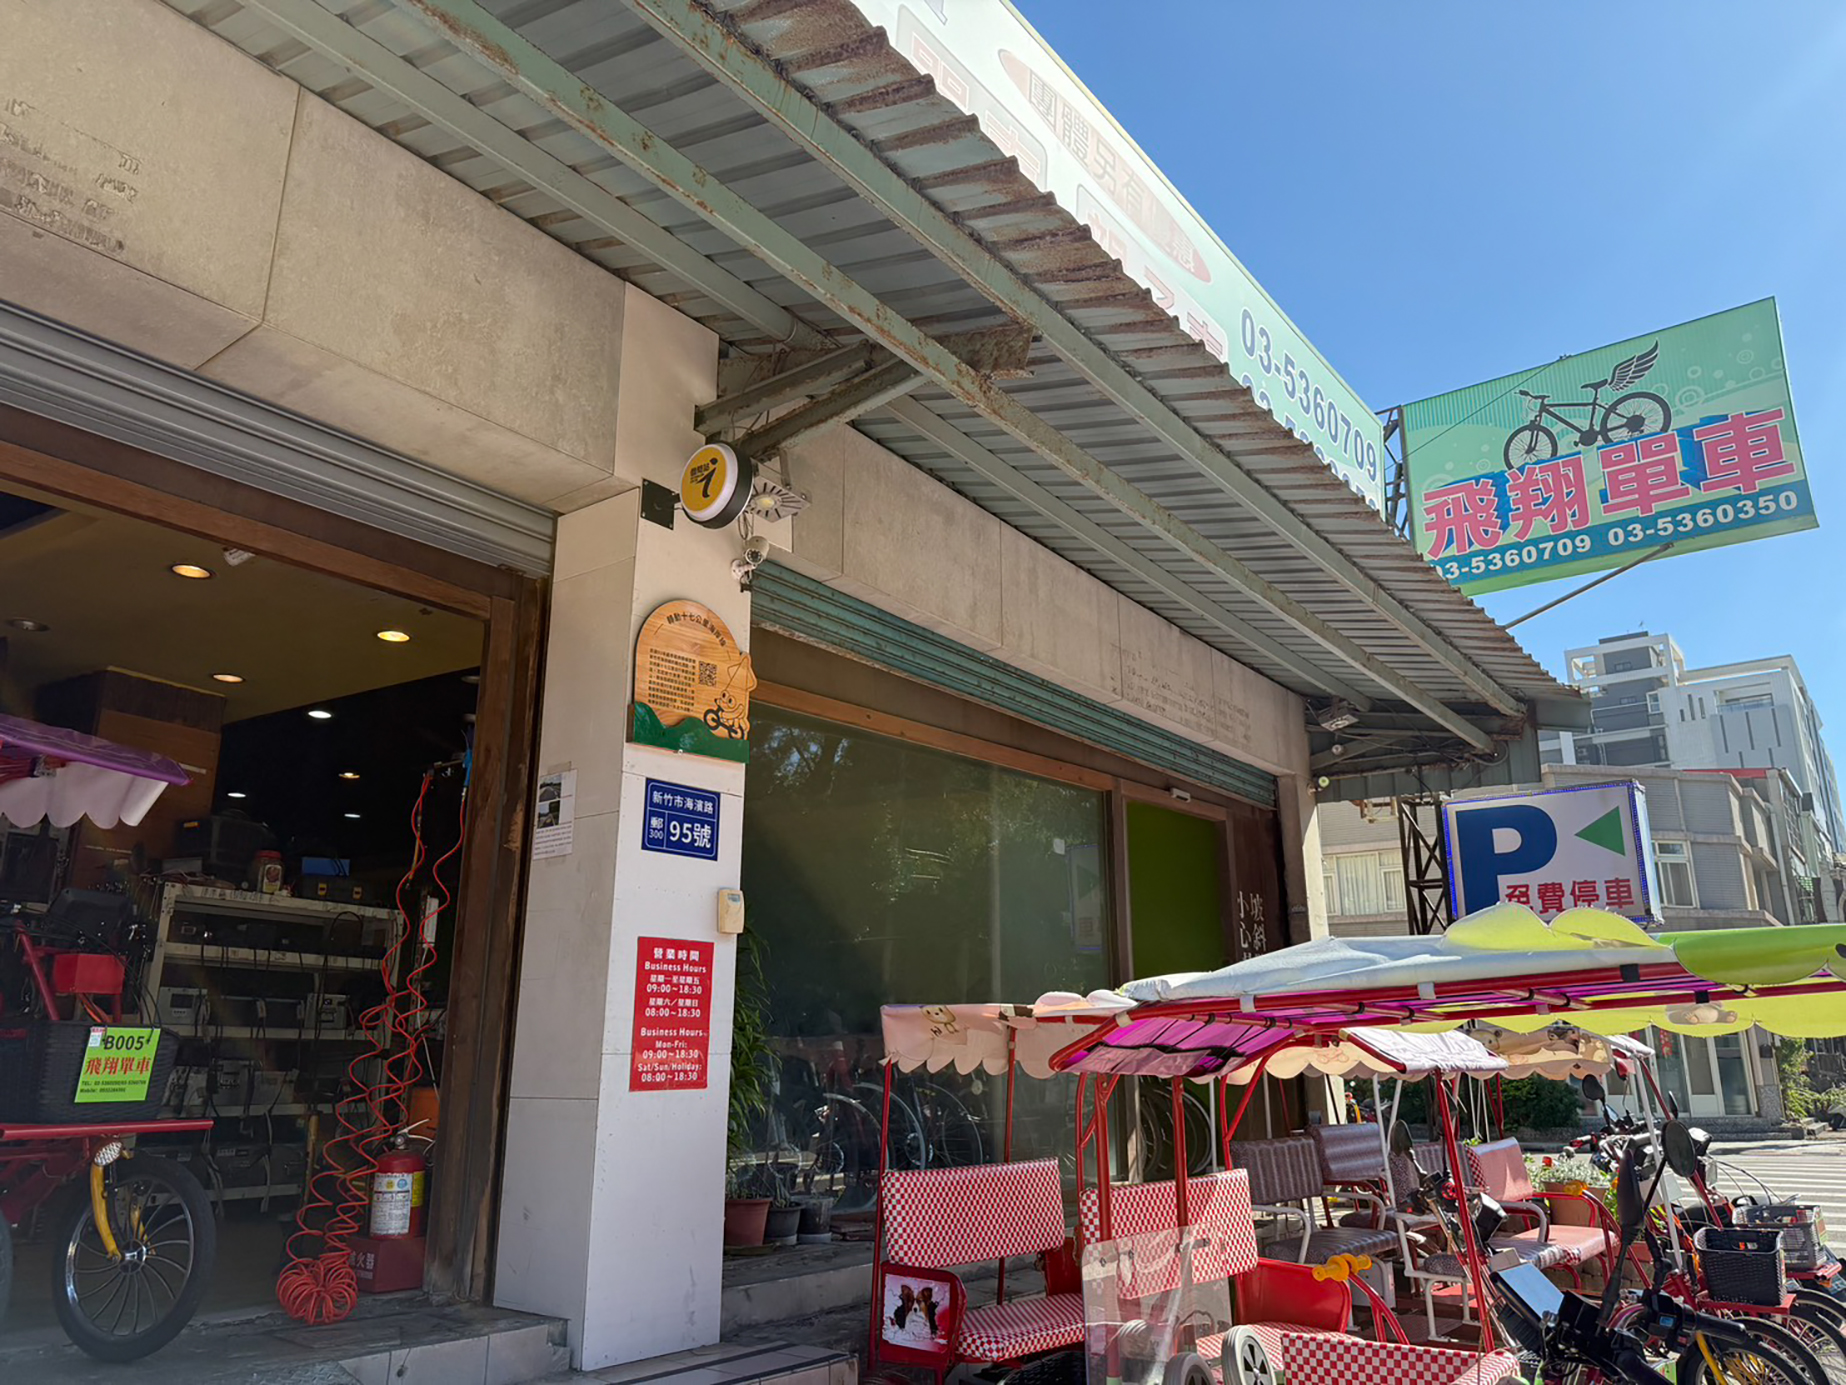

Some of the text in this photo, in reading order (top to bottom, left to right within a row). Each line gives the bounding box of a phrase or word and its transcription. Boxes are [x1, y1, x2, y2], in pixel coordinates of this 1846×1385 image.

[1028, 68, 1196, 273] 團體另有惠
[1240, 306, 1378, 483] 03-5360709
[1422, 407, 1796, 560] 飛翔單車
[1607, 490, 1798, 547] 03-5360350
[652, 791, 714, 815] 新竹市海濱路
[649, 829, 664, 840] 300
[650, 817, 664, 830] 郵
[669, 820, 712, 848] 95號
[1455, 804, 1558, 916] P
[1505, 877, 1635, 915] 免費停車
[1237, 891, 1251, 960] 小心
[653, 947, 700, 961] 營業時間
[644, 961, 706, 973] Business Hours
[650, 974, 700, 985] 星期一至星期五
[104, 1035, 145, 1050] B005
[640, 1027, 677, 1036] Business
[85, 1056, 152, 1075] 飛翔單車
